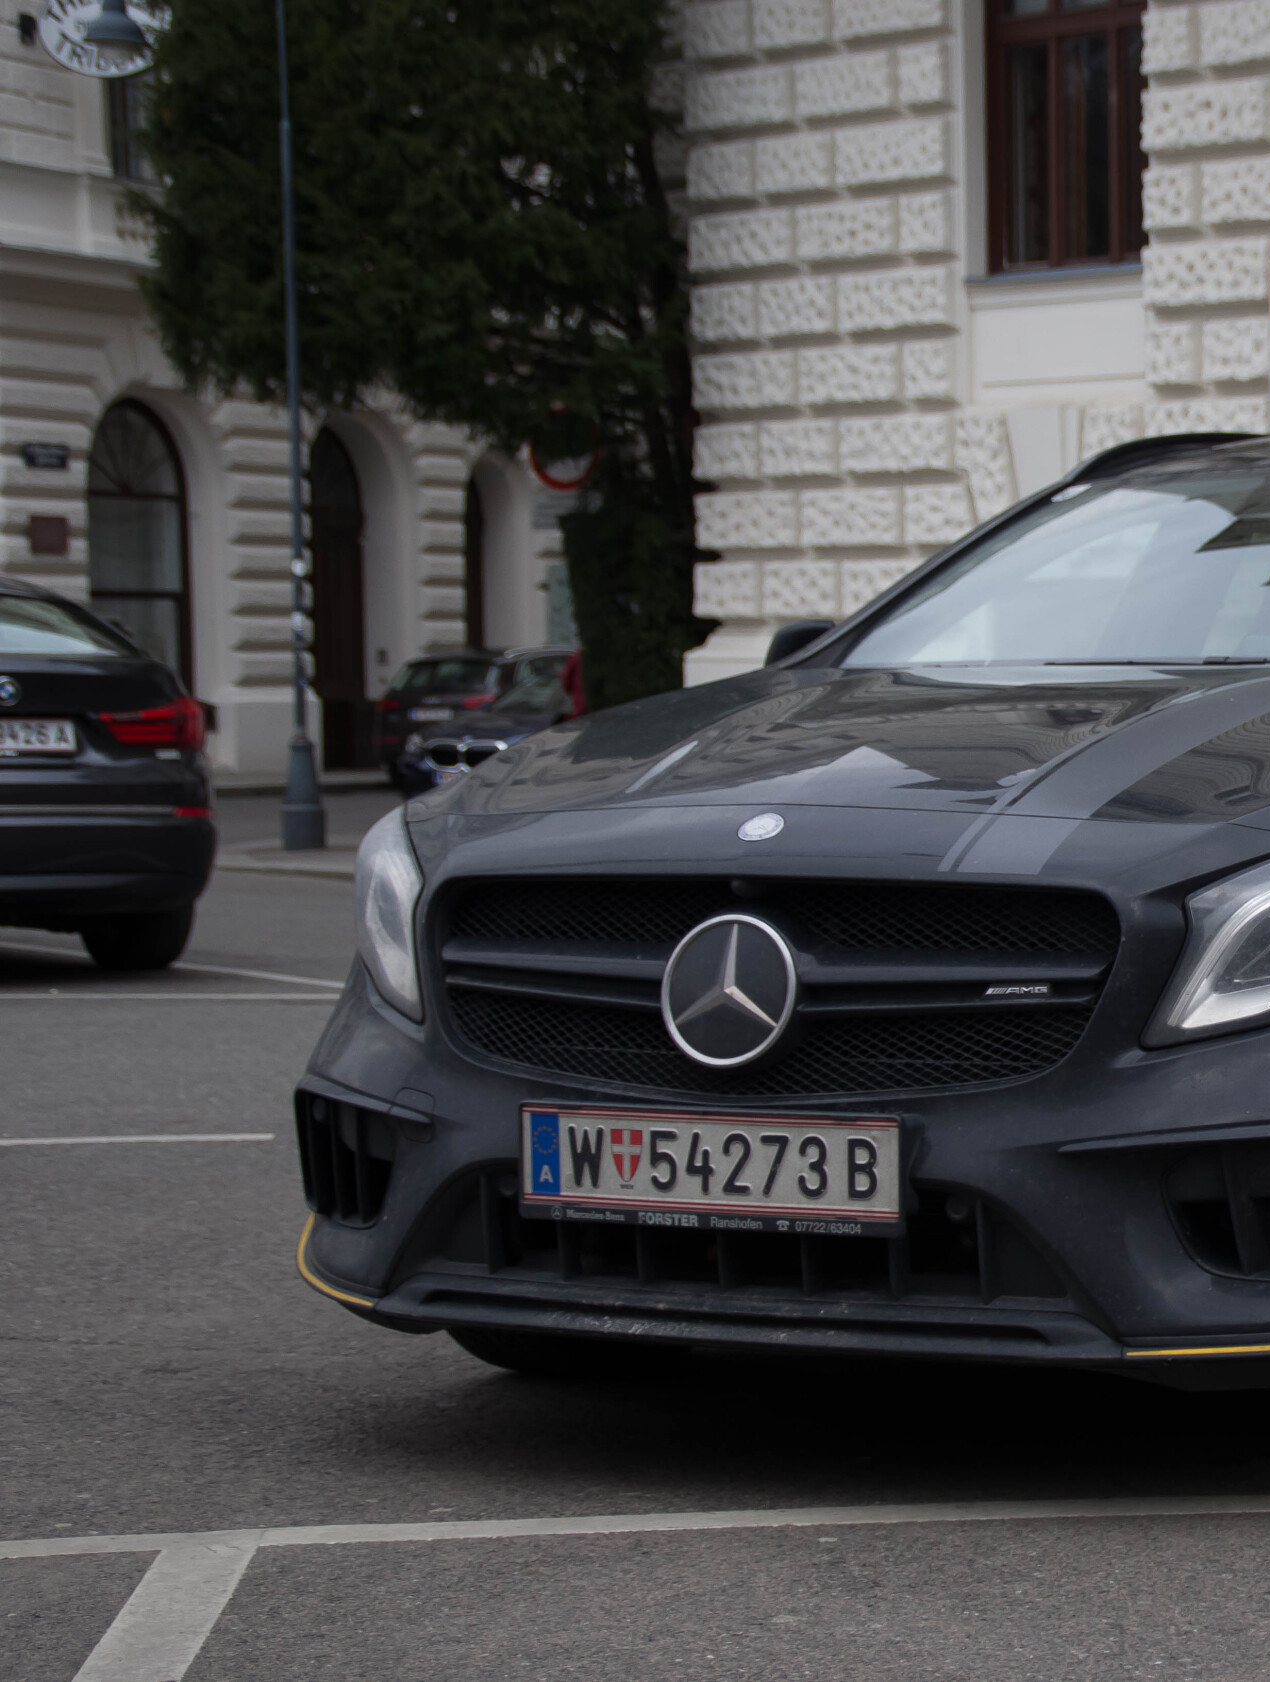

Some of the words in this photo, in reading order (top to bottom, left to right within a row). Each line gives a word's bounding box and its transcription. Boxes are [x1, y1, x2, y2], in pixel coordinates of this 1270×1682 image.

[1004, 986, 1048, 994] AMG
[568, 1125, 604, 1188] W
[649, 1128, 828, 1199] 54273
[846, 1136, 878, 1200] B
[539, 1165, 554, 1183] A
[638, 1212, 699, 1227] FORSTER
[710, 1216, 763, 1231] Ranshofen
[795, 1221, 862, 1235] 07722/63404
